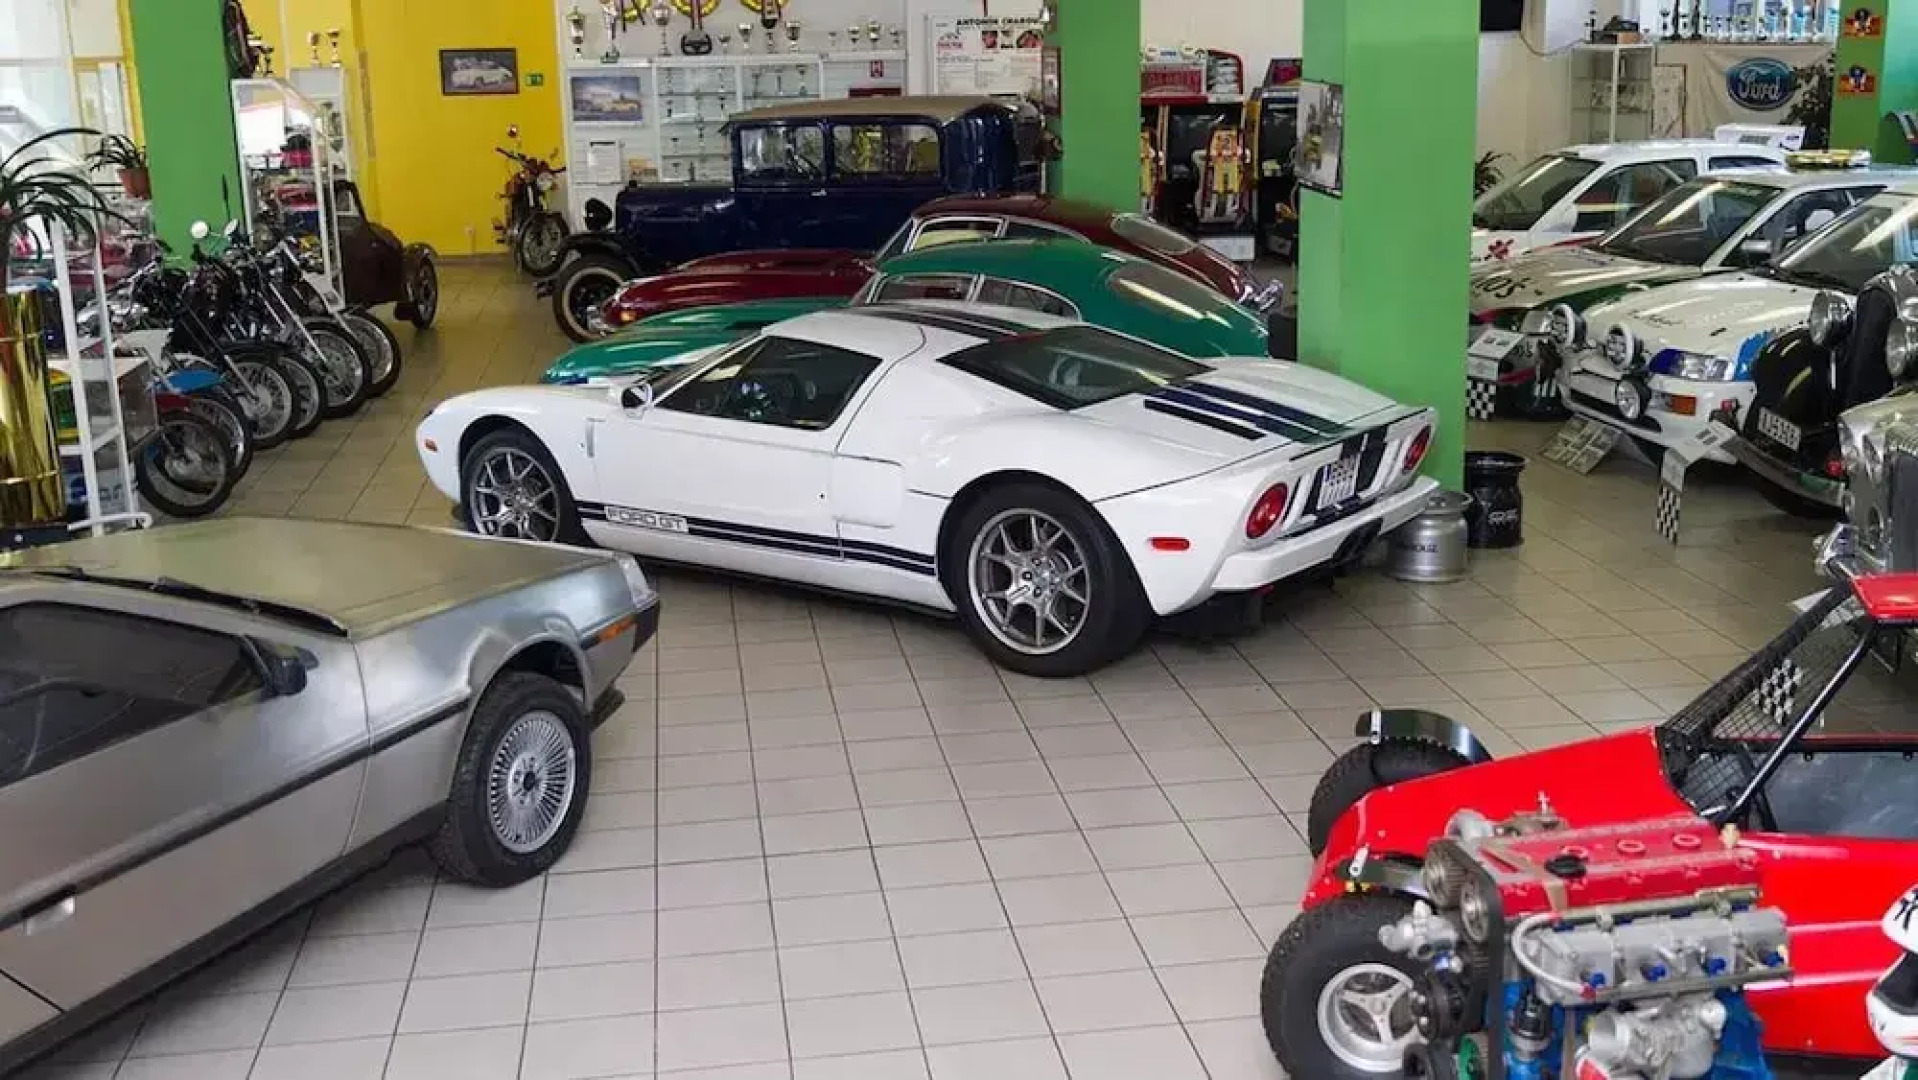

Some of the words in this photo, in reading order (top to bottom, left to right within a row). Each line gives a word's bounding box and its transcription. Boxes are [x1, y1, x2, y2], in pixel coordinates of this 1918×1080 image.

[1738, 66, 1780, 101] Ford
[607, 507, 657, 527] FORD
[659, 516, 684, 532] GT
